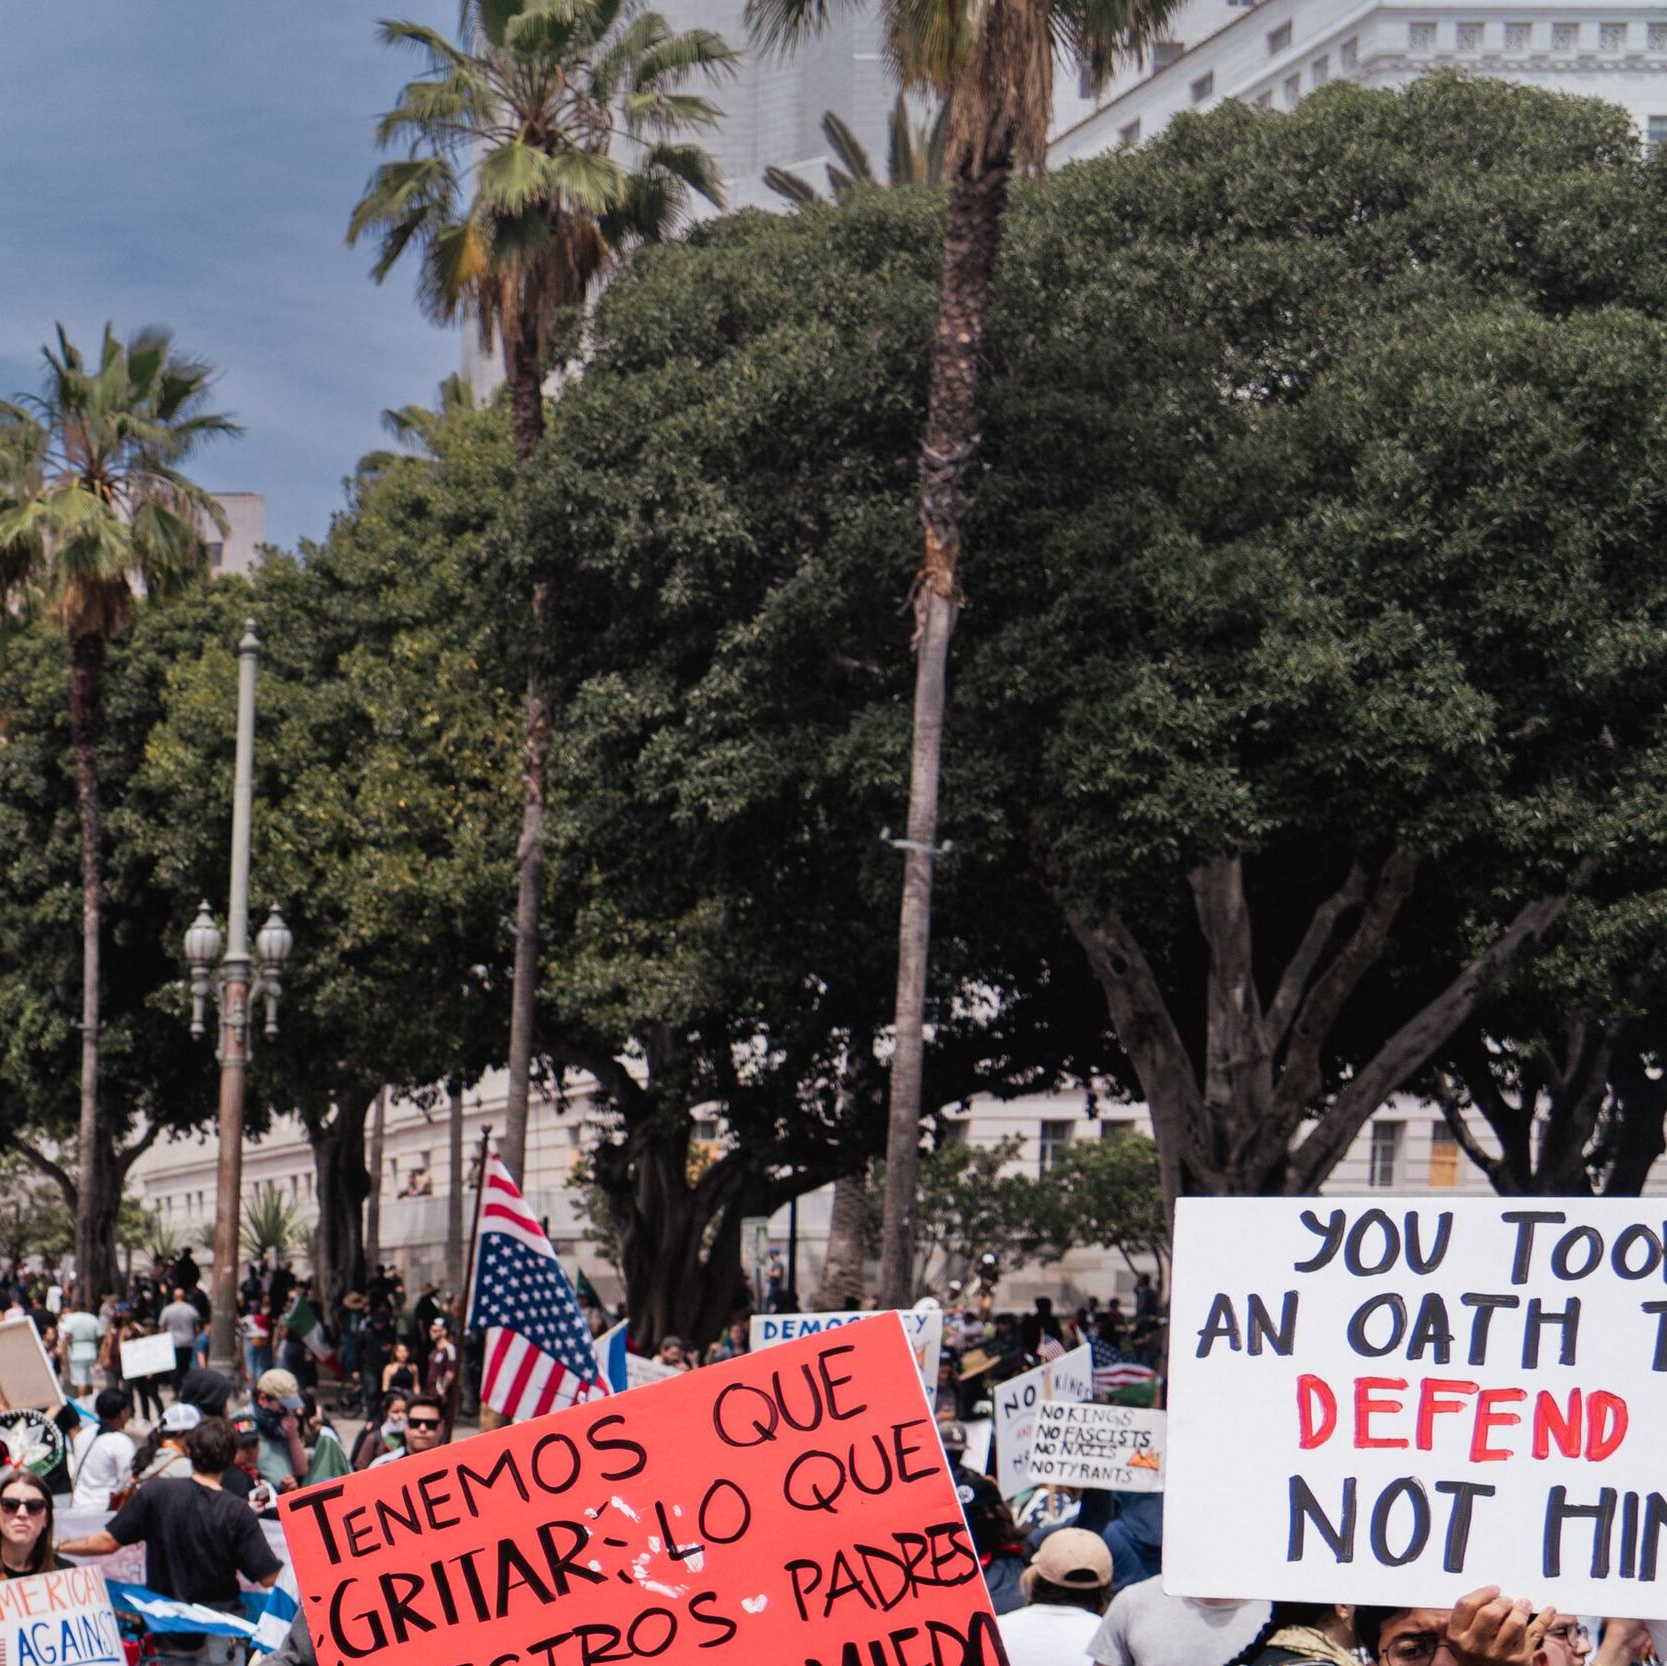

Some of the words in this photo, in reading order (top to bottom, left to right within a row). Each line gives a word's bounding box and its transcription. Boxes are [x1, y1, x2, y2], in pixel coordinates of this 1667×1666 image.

[1295, 1208, 1454, 1278] YOU
[1501, 1211, 1667, 1284] TOO
[1196, 1291, 1300, 1358] AN
[1347, 1292, 1582, 1369] OATH
[290, 1415, 648, 1564] TENEMOS
[714, 1345, 868, 1448] QUE
[1034, 1442, 1056, 1456] NO
[1037, 1424, 1060, 1439] NO
[1064, 1426, 1152, 1448] FASCISTS
[1041, 1405, 1064, 1420] NO
[1068, 1407, 1135, 1427] KINGS
[1297, 1373, 1629, 1463] DEFEND
[1030, 1460, 1054, 1474] NO
[1057, 1462, 1134, 1483] TYRANTS
[330, 1519, 610, 1661] GRITAR
[657, 1479, 752, 1562] LO
[784, 1419, 942, 1513] QUE
[1287, 1475, 1495, 1573] NOT
[785, 1521, 979, 1622] PADRES
